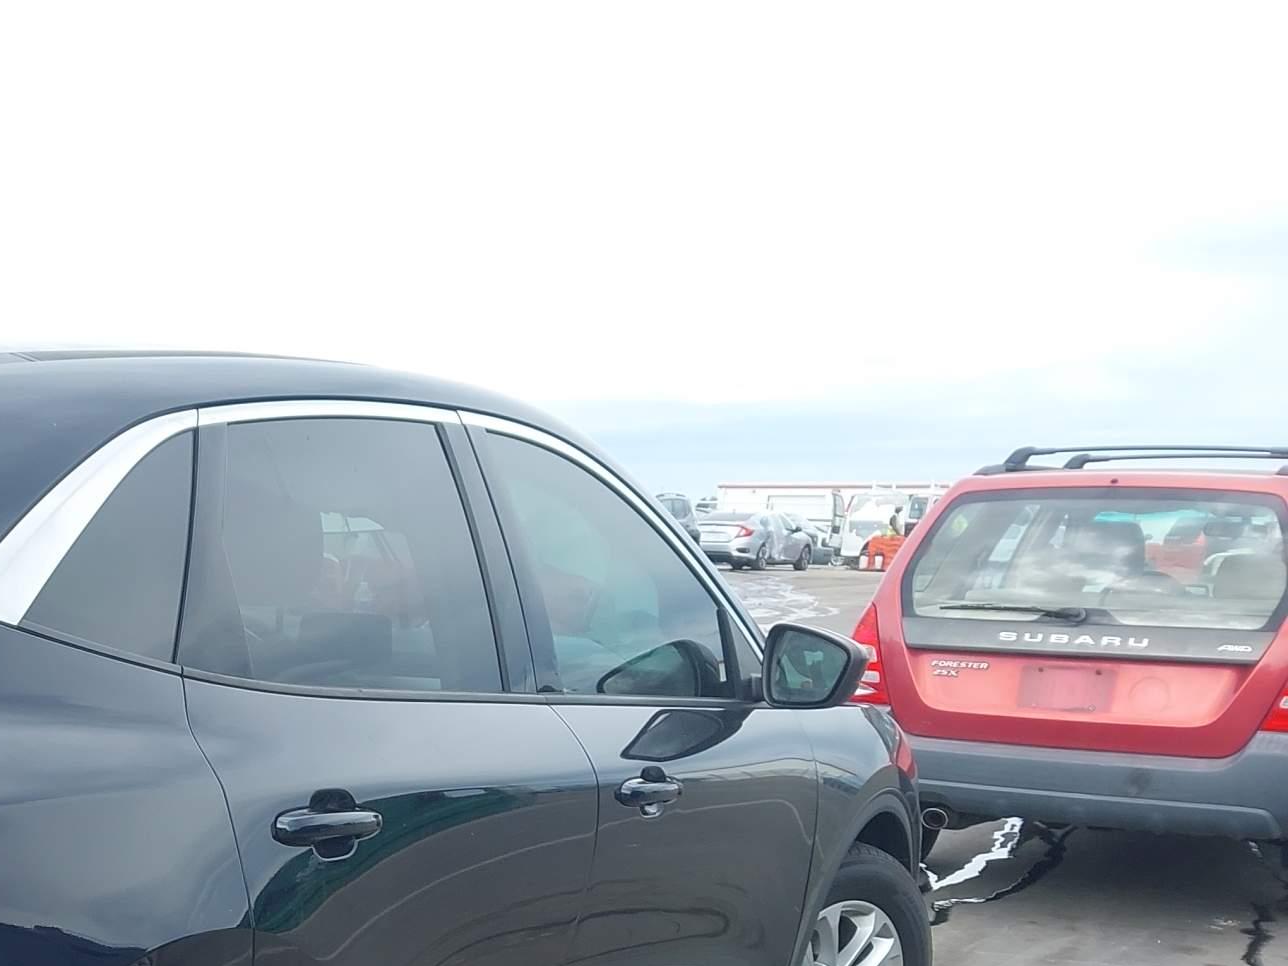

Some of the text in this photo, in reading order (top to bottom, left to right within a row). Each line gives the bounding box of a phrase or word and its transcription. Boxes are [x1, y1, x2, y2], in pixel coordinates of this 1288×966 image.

[998, 631, 1150, 648] SUBARU
[1216, 644, 1253, 652] AWD
[931, 659, 989, 670] FORESTER
